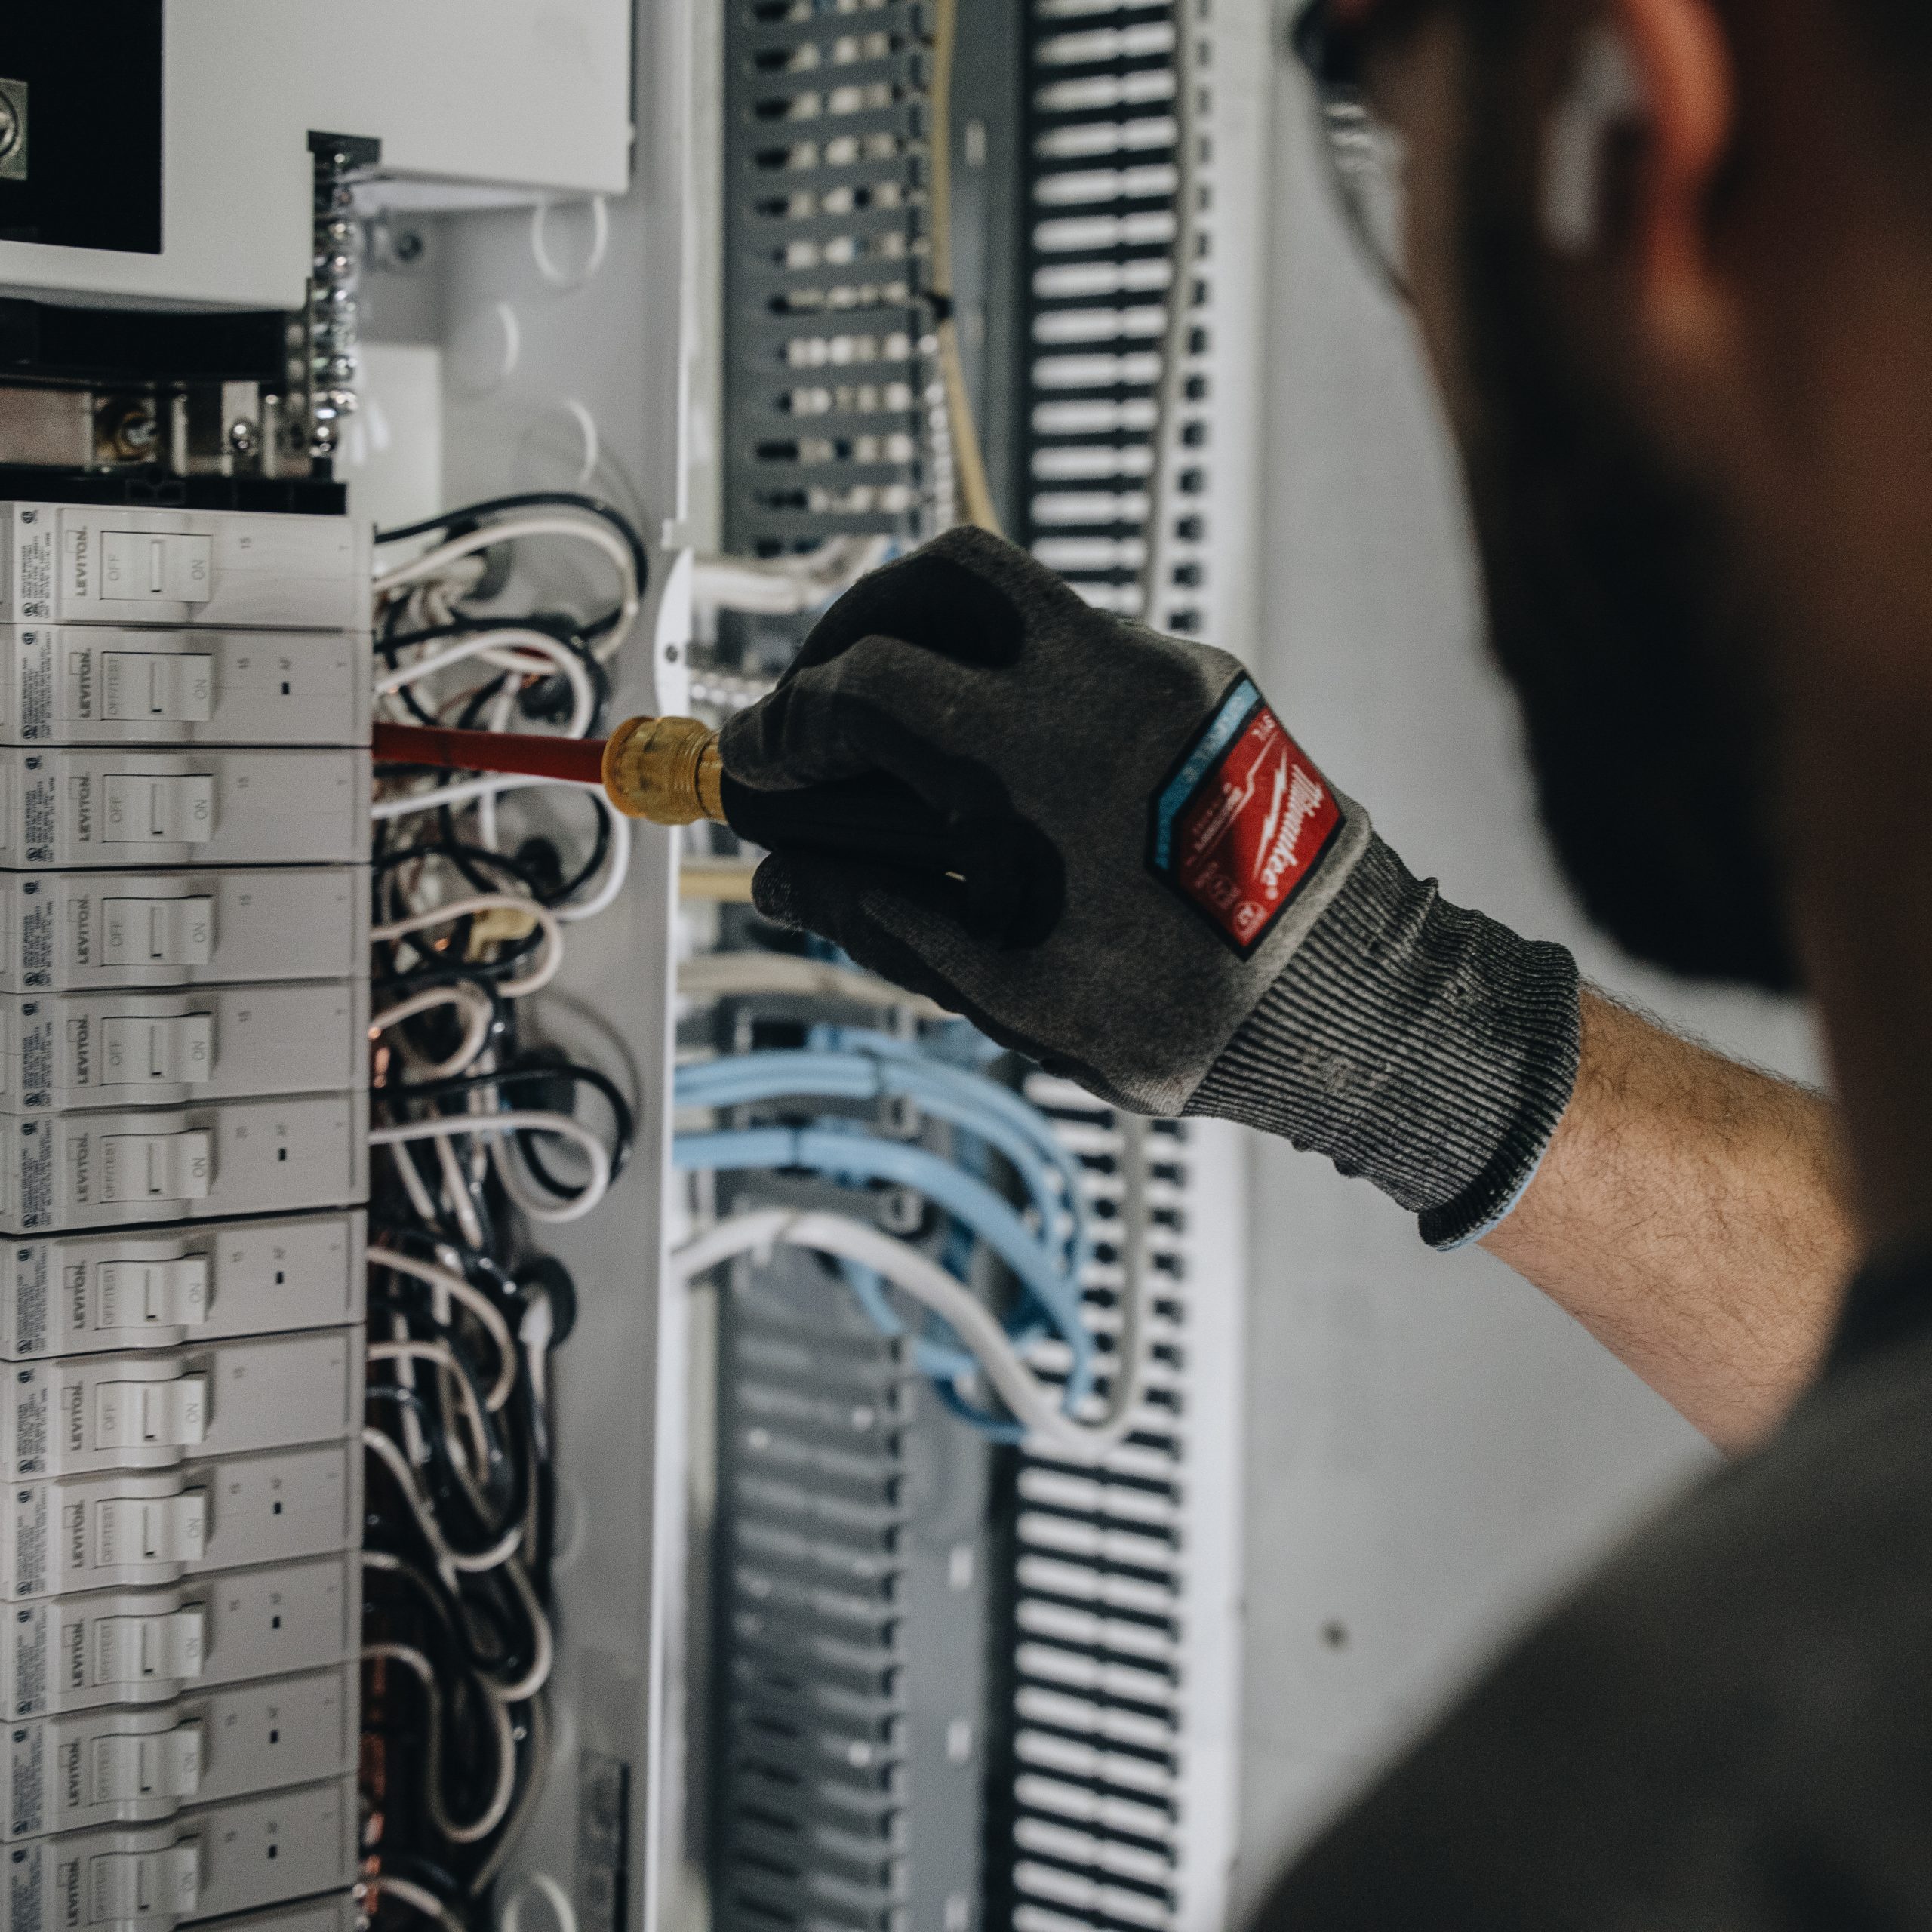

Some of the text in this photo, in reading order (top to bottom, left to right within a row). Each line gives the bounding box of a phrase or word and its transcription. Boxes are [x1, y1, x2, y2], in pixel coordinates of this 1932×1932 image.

[240, 537, 251, 549] 15
[75, 530, 88, 596] LEVITON
[109, 554, 119, 581] OFF
[191, 559, 204, 580] ON
[238, 658, 249, 669] 15
[79, 652, 91, 718] LEVITON
[109, 658, 119, 716] OFF/TEST
[195, 679, 207, 699] ON
[238, 777, 248, 788] 15
[79, 776, 91, 841] LEVITON
[112, 796, 122, 823] OFF
[195, 799, 208, 819] ON
[77, 899, 89, 964] LEVITON
[111, 921, 123, 947] OFF
[193, 922, 205, 943] ON
[76, 1017, 88, 1084] LEVITON
[110, 1040, 122, 1066] OFF
[193, 1041, 205, 1061] ON
[77, 1137, 89, 1202] LEVITON
[105, 1142, 115, 1199] OFF/TEST
[192, 1157, 205, 1177] ON
[74, 1264, 85, 1329] LEVITON
[103, 1268, 115, 1325] OFF/TEST
[188, 1284, 201, 1303] ON
[71, 1385, 83, 1450] LEVITON
[104, 1405, 116, 1431] OFF
[186, 1403, 199, 1424] ON
[72, 1503, 84, 1568] LEVITON
[103, 1506, 115, 1563] OFF/TEST
[188, 1518, 201, 1538] ON
[72, 1622, 83, 1687] LEVITON
[186, 1637, 199, 1658] ON
[68, 1742, 80, 1807] LEVITON
[67, 1862, 79, 1926] LEVITON
